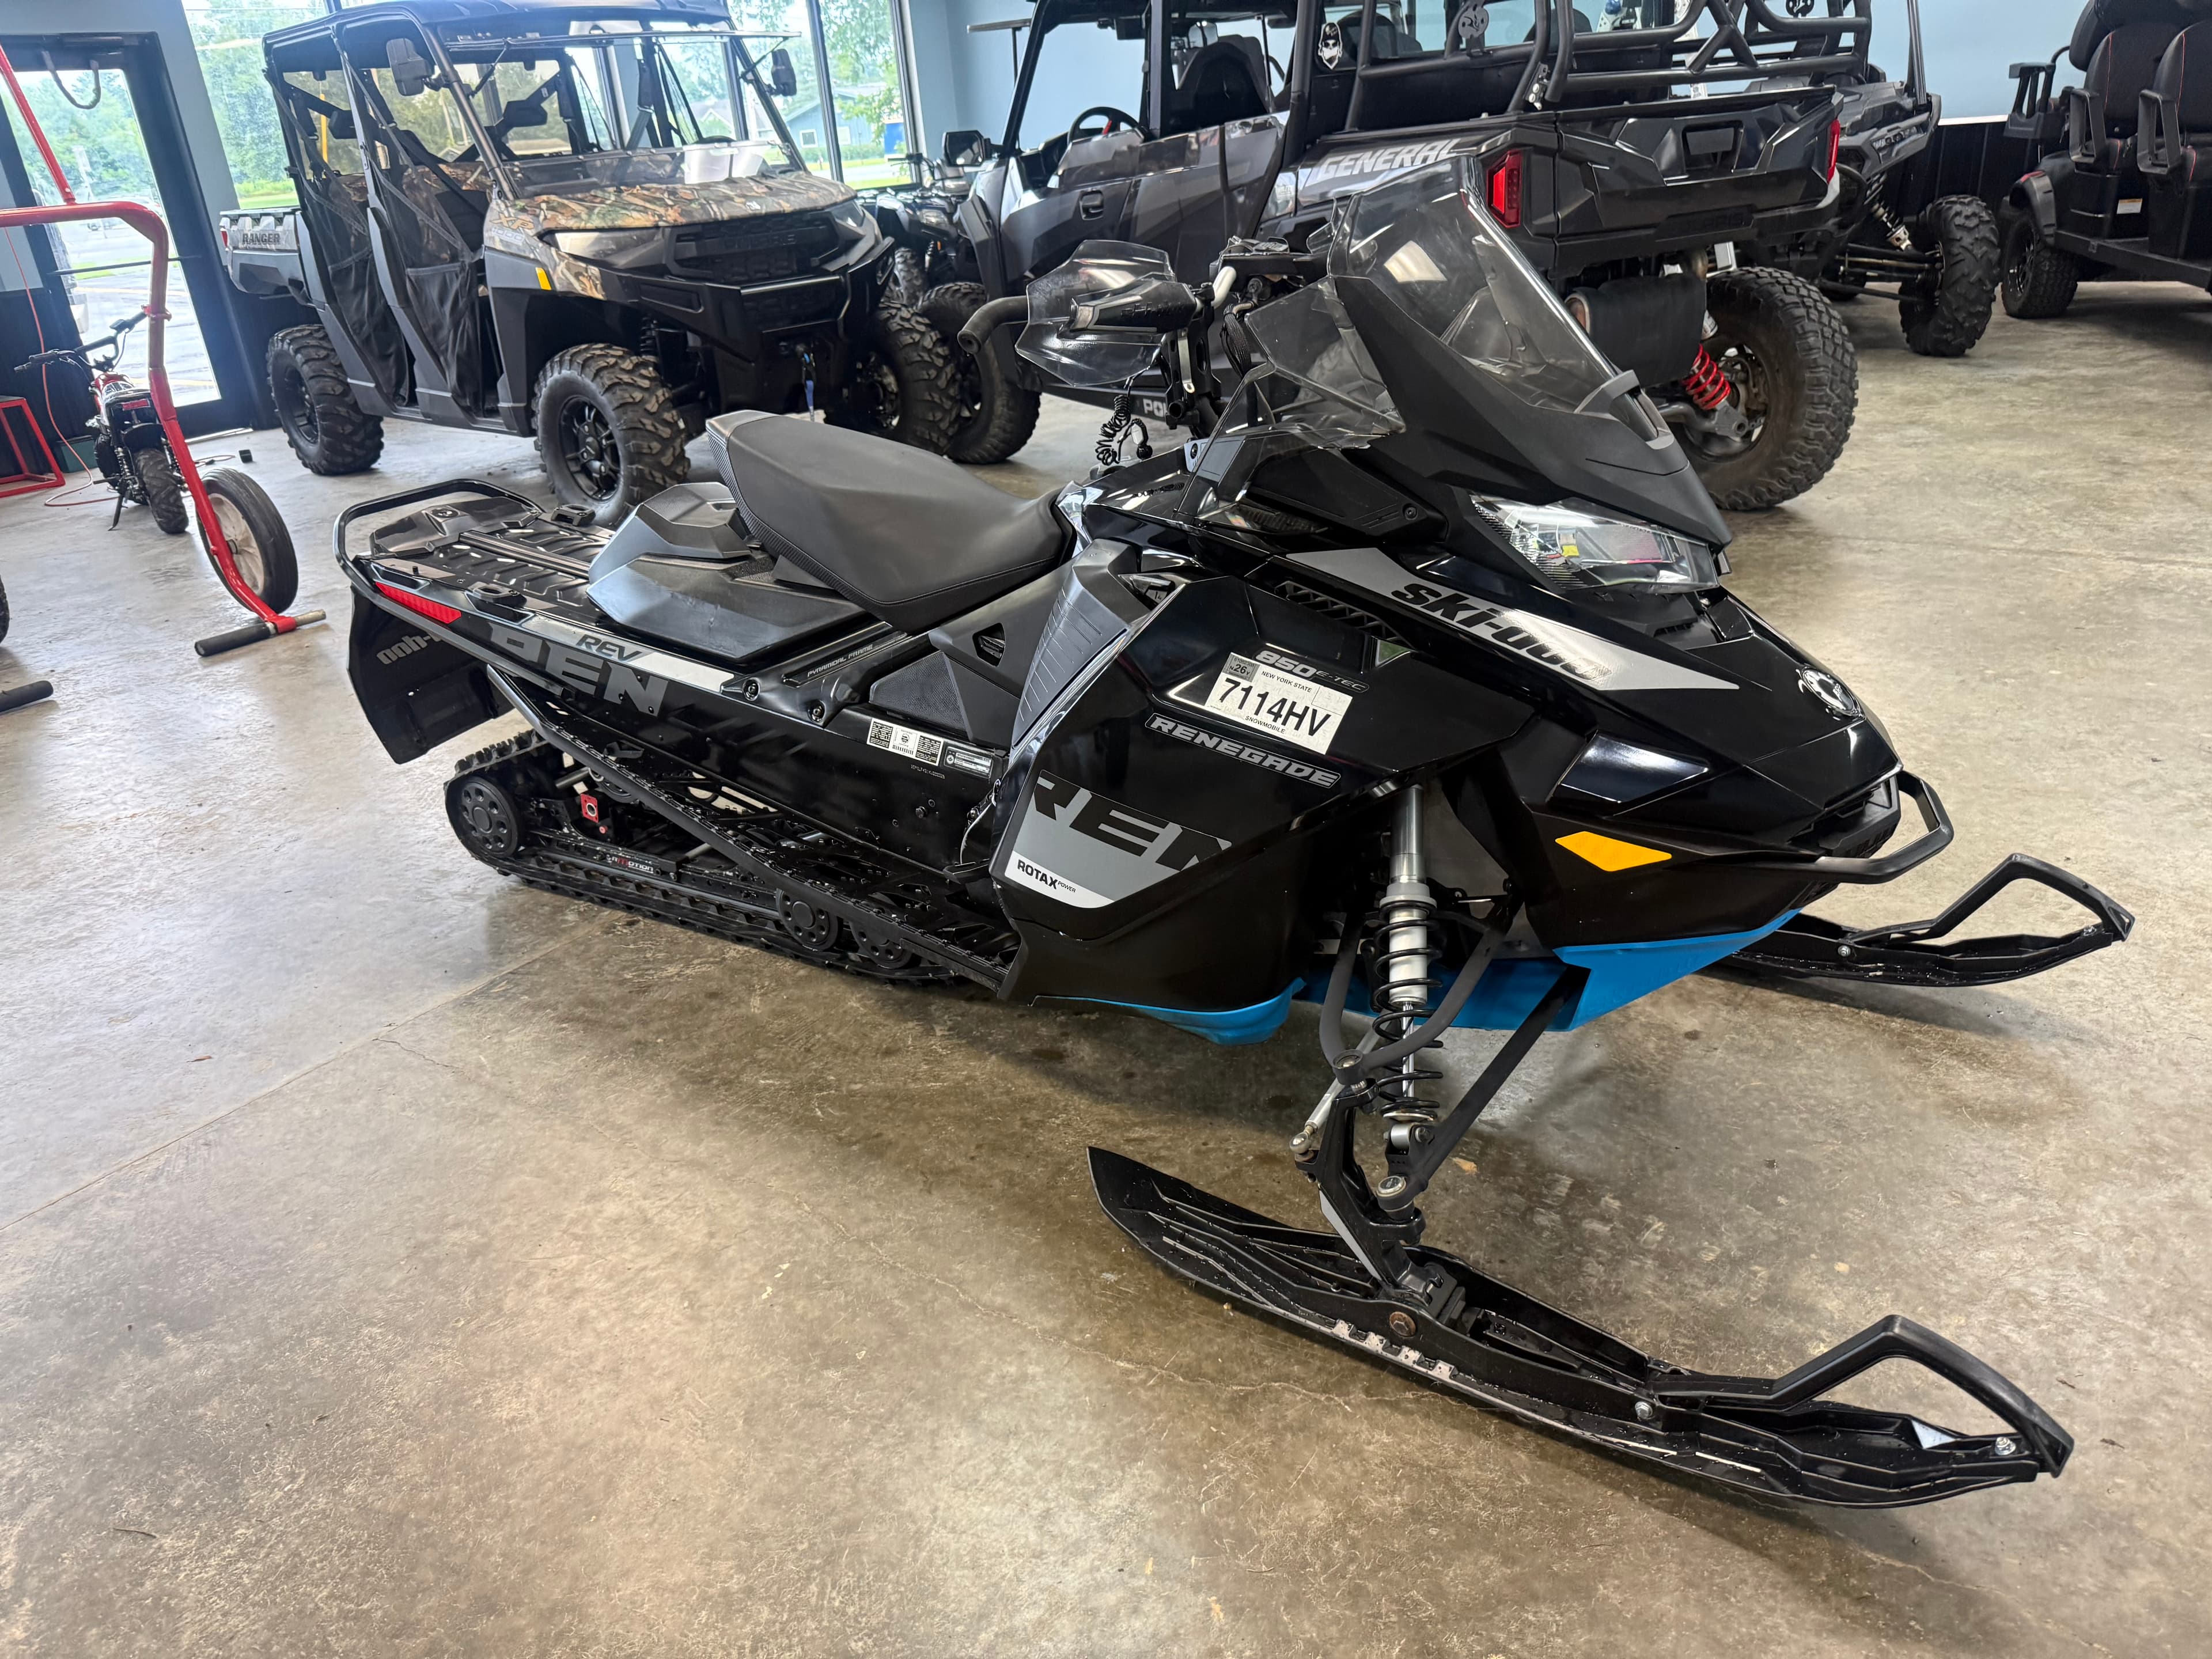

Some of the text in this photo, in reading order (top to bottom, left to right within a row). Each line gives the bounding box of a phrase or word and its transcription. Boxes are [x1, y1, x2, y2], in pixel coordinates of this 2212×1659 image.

[1316, 138, 1461, 181] GENERAL
[488, 212, 535, 230] XP
[242, 233, 281, 245] RANGER
[575, 633, 643, 662] REV
[1255, 650, 1318, 678] 850
[1316, 671, 1366, 691] E-TEC
[1261, 670, 1313, 693] NEW YORK STATE
[1218, 677, 1332, 737] 7114HV
[1245, 715, 1286, 734] SNOWMOBILE
[1150, 716, 1339, 787] RENEGADE
[1017, 858, 1077, 893] ROTAX POWER
